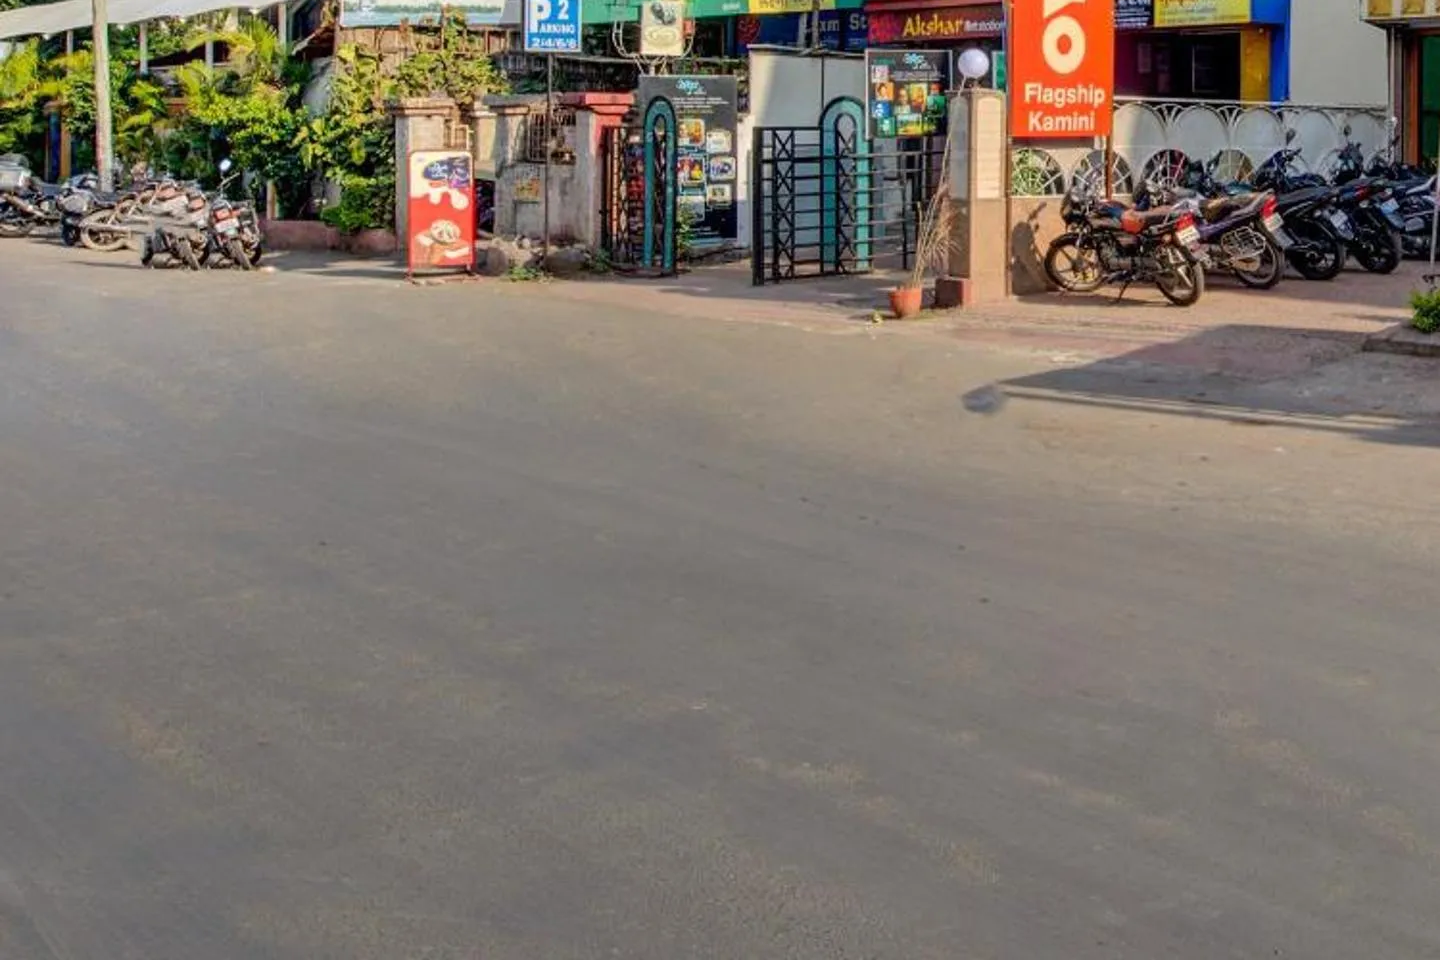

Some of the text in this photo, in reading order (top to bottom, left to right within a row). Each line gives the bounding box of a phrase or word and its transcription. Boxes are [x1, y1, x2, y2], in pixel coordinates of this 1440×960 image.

[902, 13, 963, 37] Akshar
[1023, 82, 1106, 109] Flagship
[1028, 110, 1096, 132] Kamini
